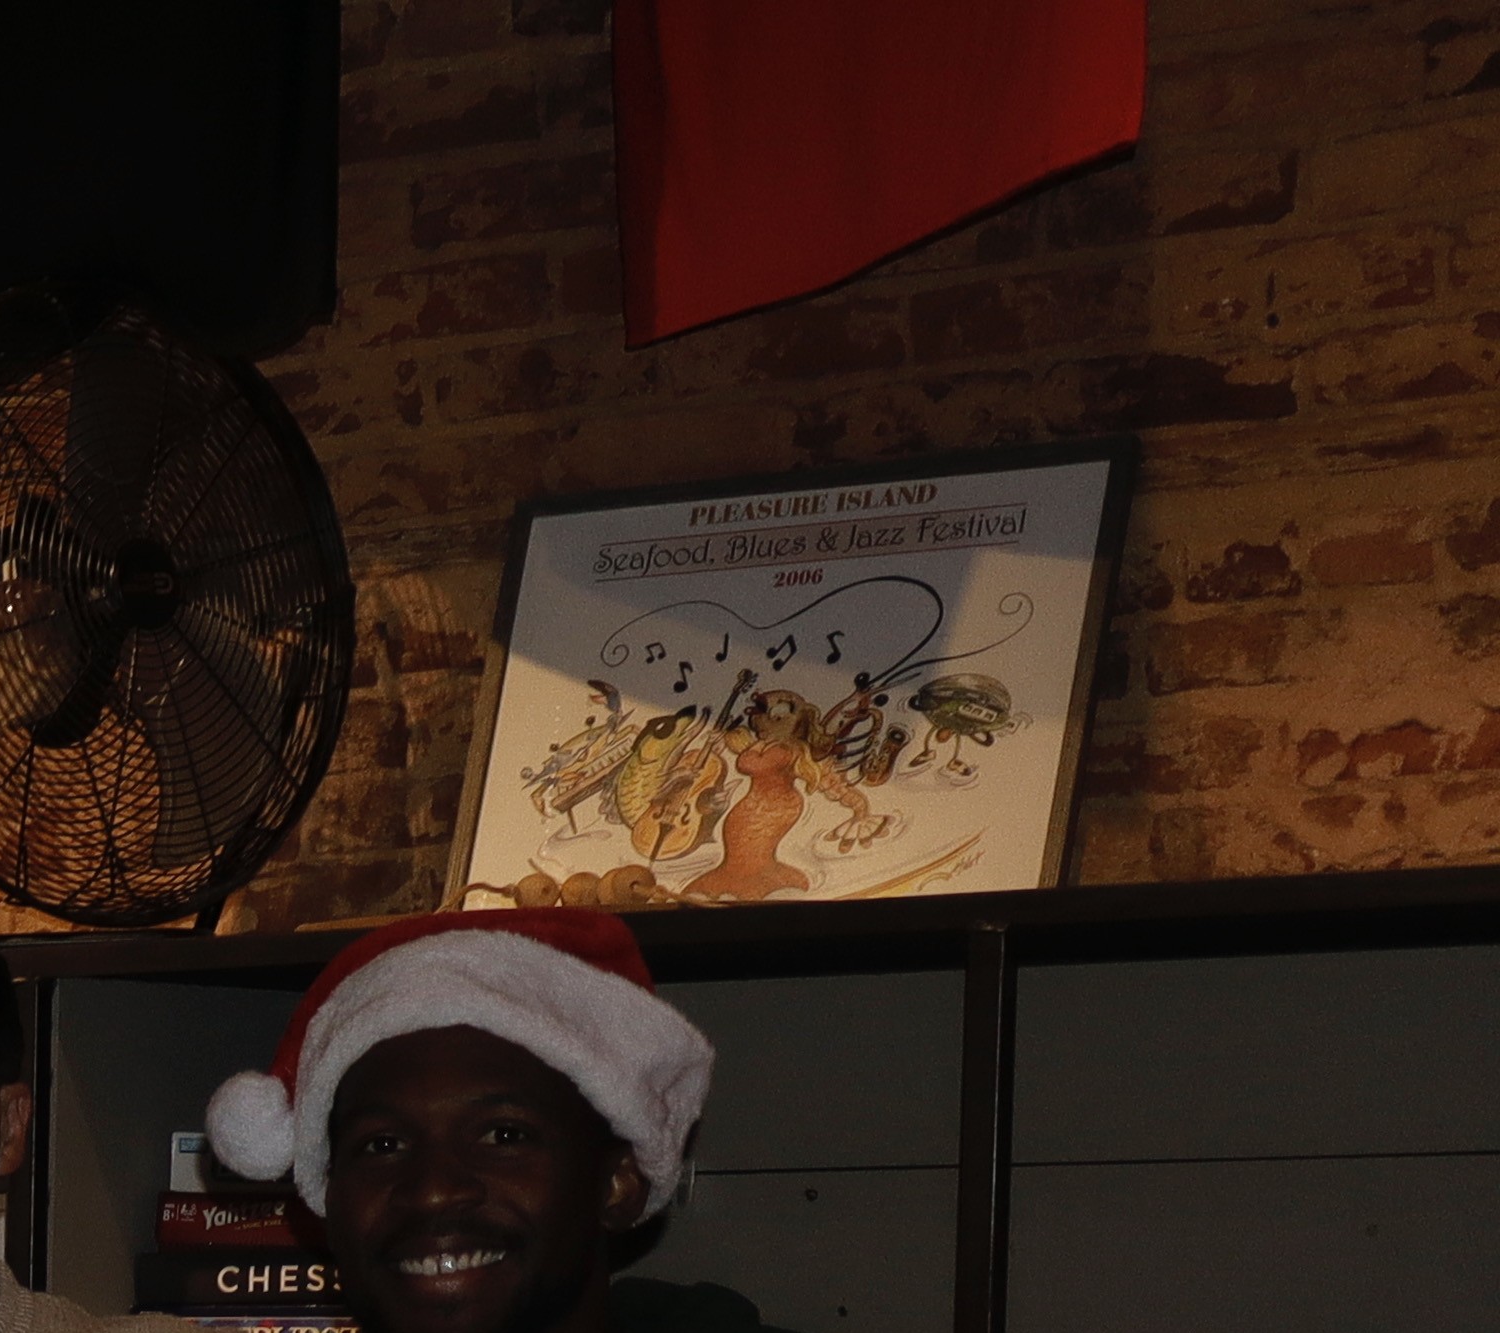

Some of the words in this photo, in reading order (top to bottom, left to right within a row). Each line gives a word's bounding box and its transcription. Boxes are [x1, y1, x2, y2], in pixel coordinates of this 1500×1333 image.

[689, 493, 828, 526] PLEASURE
[834, 484, 938, 515] ISLAND
[592, 540, 714, 575] Seafood,
[725, 532, 808, 562] Blues
[816, 527, 837, 551] &
[843, 520, 906, 554] Jazz
[916, 509, 1027, 543] Festival
[773, 568, 824, 588] 2006
